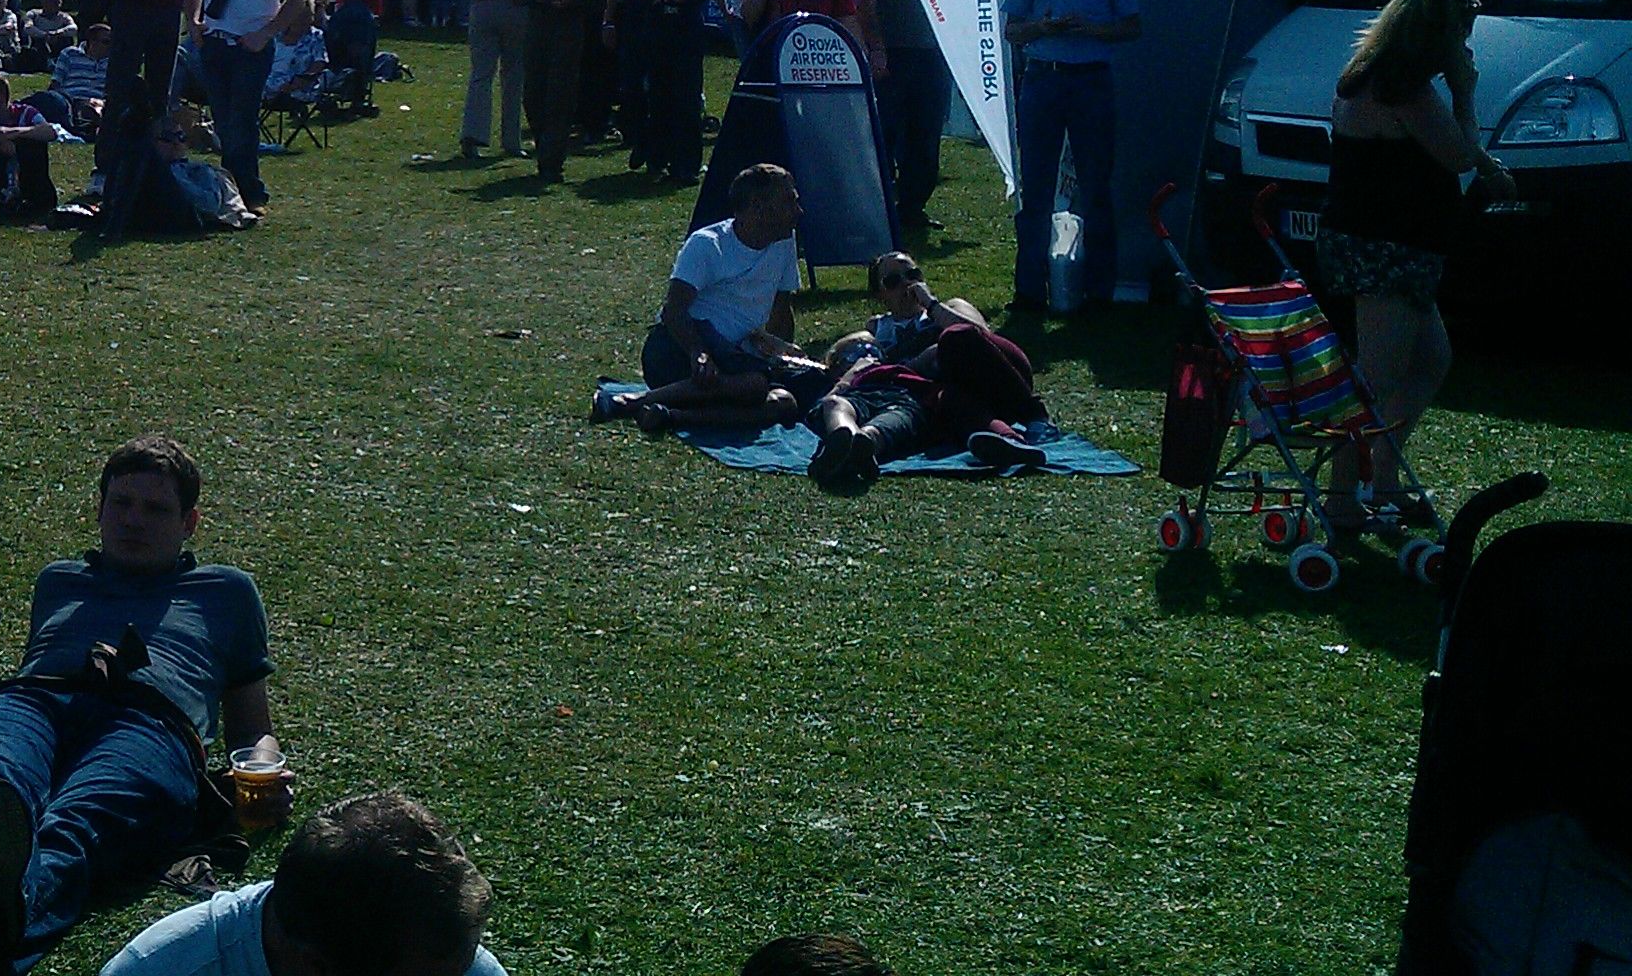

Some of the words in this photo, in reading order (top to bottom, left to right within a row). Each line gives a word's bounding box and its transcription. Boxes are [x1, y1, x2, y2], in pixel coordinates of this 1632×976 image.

[808, 39, 844, 51] ROYAL
[790, 53, 809, 65] AIR
[811, 53, 846, 65] FORCE
[791, 68, 850, 81] RESERVES
[1291, 212, 1316, 237] NU
